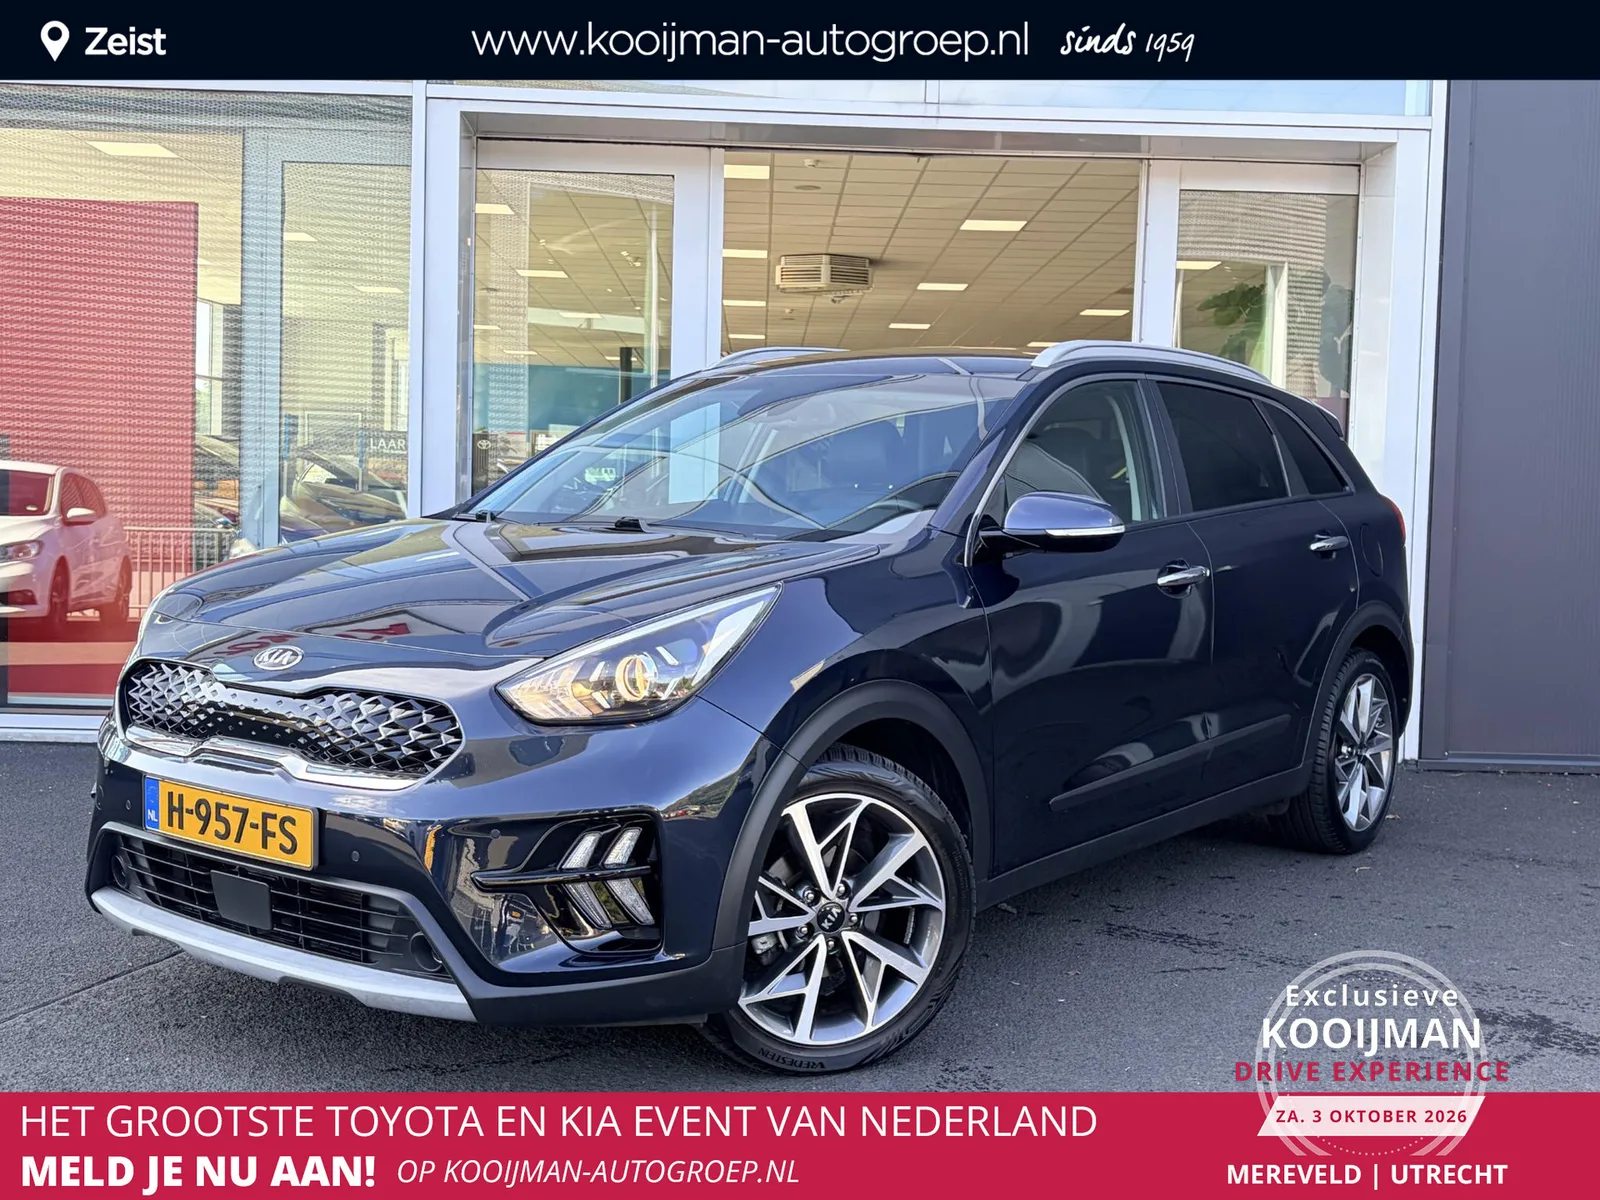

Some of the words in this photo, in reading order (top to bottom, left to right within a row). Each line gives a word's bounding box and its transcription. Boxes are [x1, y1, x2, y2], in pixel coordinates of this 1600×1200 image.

[257, 648, 293, 666] KIA
[147, 808, 158, 822] NL
[167, 791, 298, 855] H-957-FS
[821, 907, 842, 930] KIA
[758, 1047, 826, 1069] VREDESTEIN
